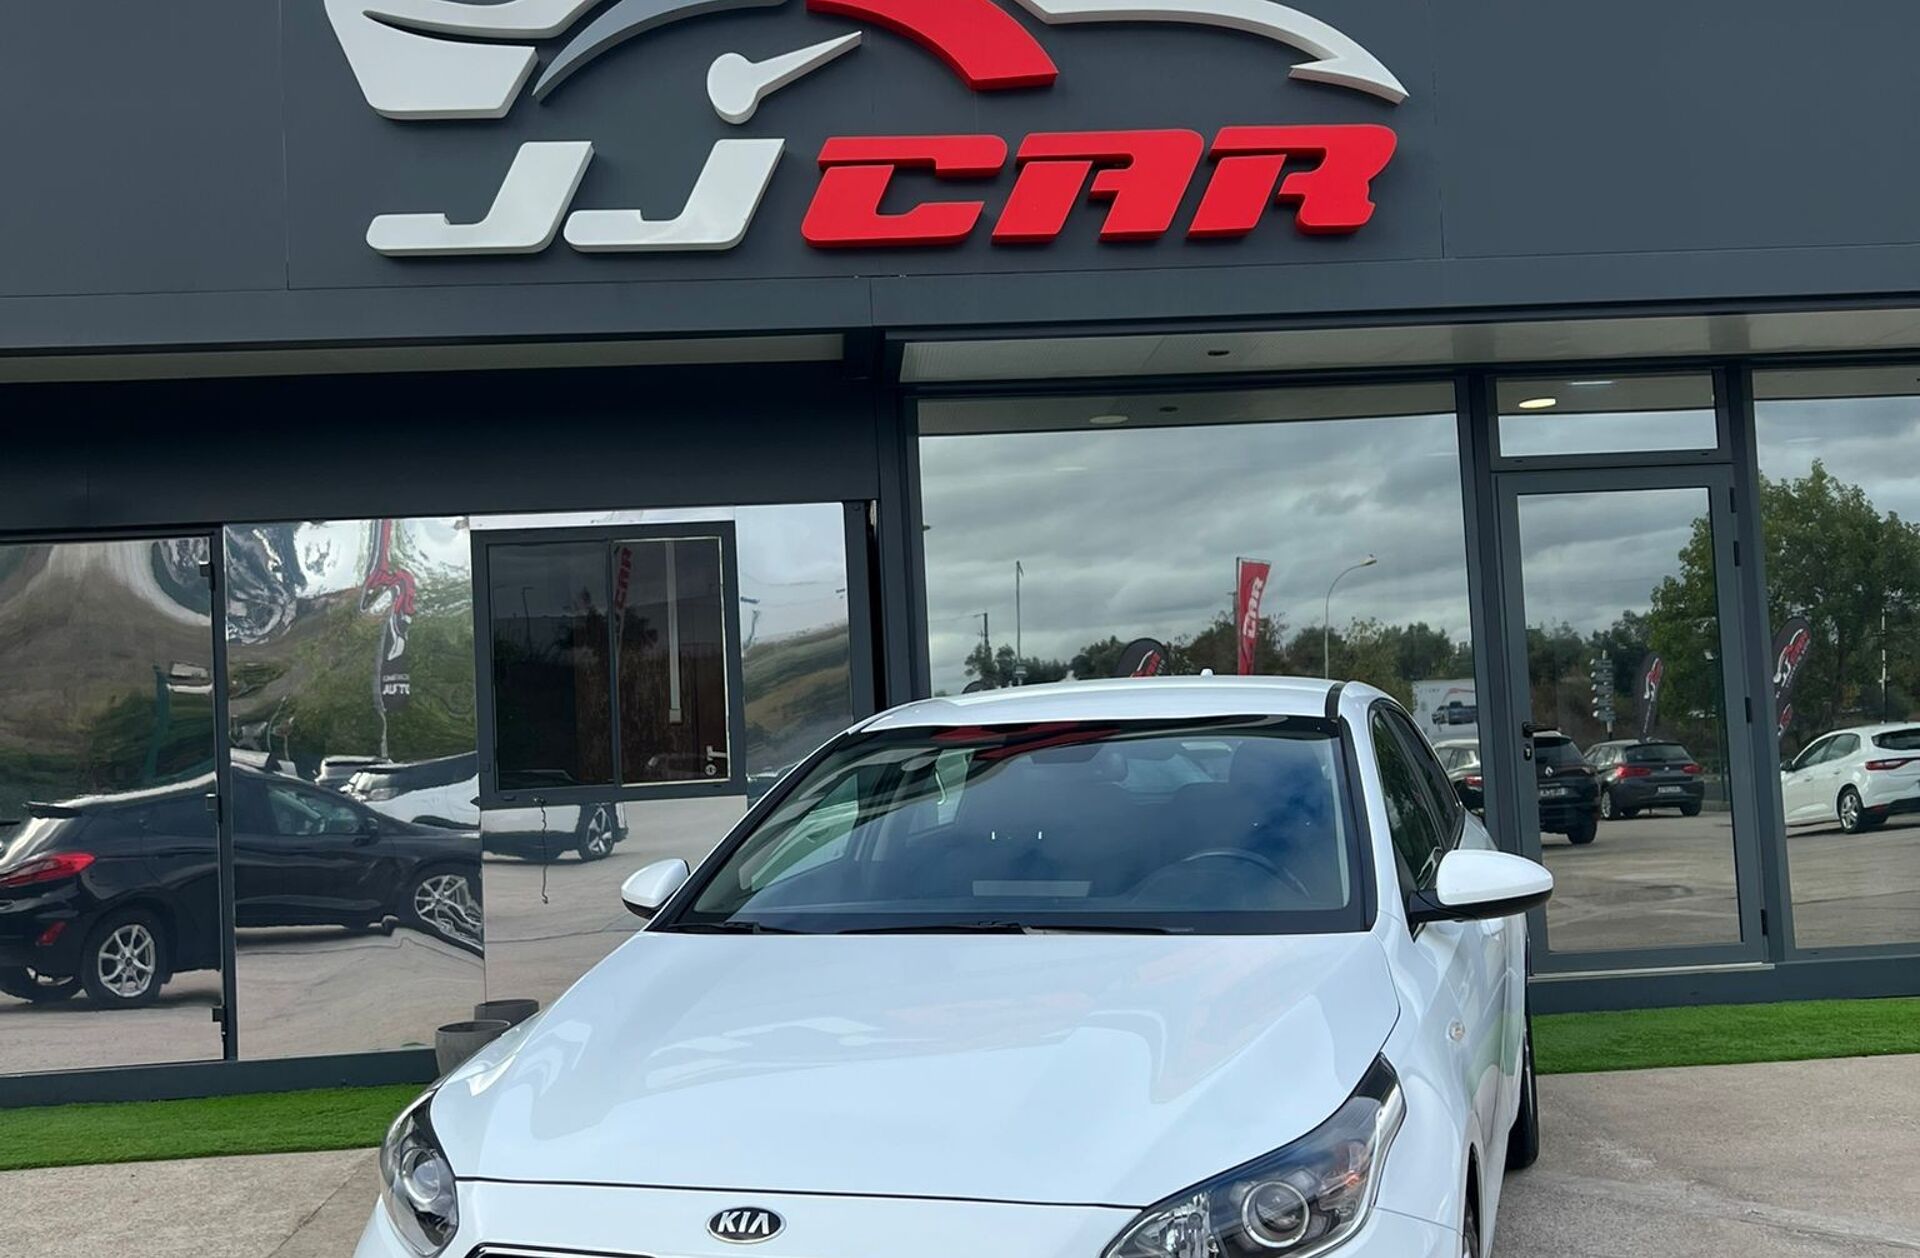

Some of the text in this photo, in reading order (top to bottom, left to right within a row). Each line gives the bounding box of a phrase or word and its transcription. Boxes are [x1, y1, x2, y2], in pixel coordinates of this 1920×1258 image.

[366, 123, 1398, 257] JJ CAR
[1243, 576, 1264, 639] CAR
[717, 1210, 770, 1235] KIA
